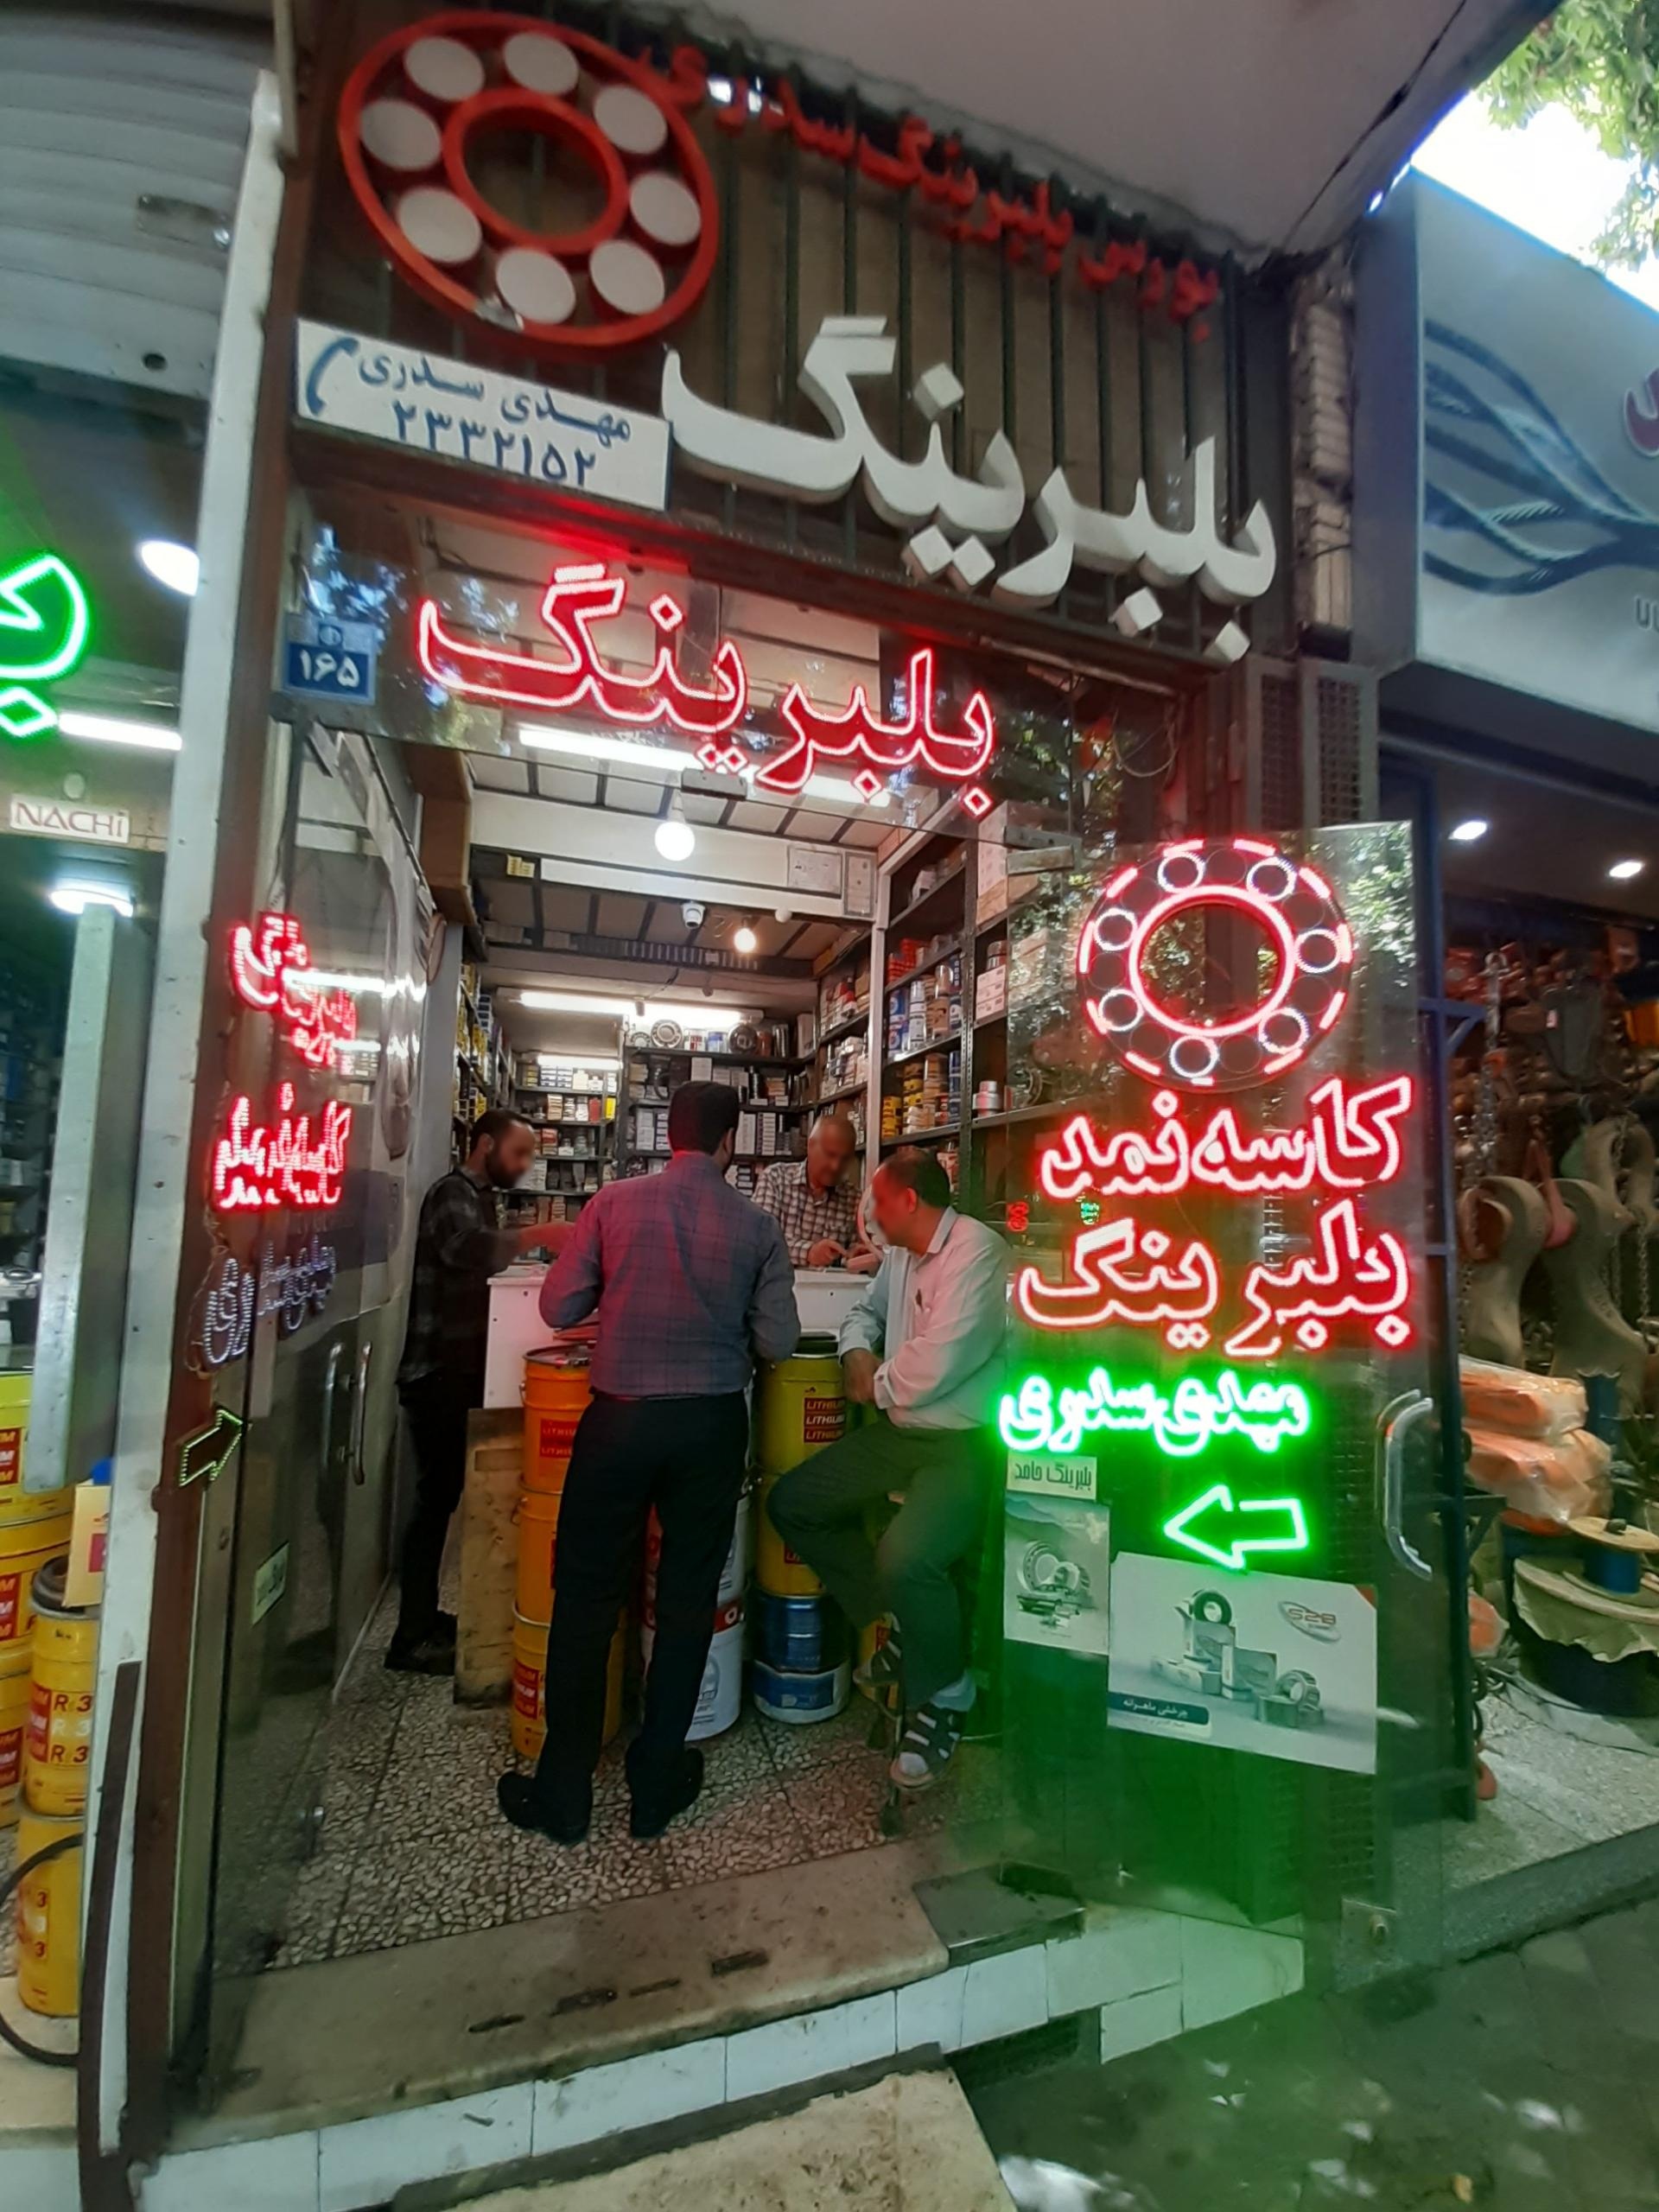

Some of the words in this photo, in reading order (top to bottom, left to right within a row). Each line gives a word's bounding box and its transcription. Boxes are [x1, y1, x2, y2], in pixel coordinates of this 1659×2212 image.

[359, 354, 485, 402] سدری
[501, 386, 632, 448] مهدی
[393, 400, 596, 487] ۲۳۳۲۱۵۲
[660, 316, 1277, 663] بلبرینگ
[300, 649, 359, 688] ۱۶۵
[418, 563, 996, 818] بلبرینگ
[1192, 1076, 1413, 1194] کاسه
[1016, 1199, 1412, 1360] بلبرینگ
[1046, 1460, 1092, 1492] بلبرینگ
